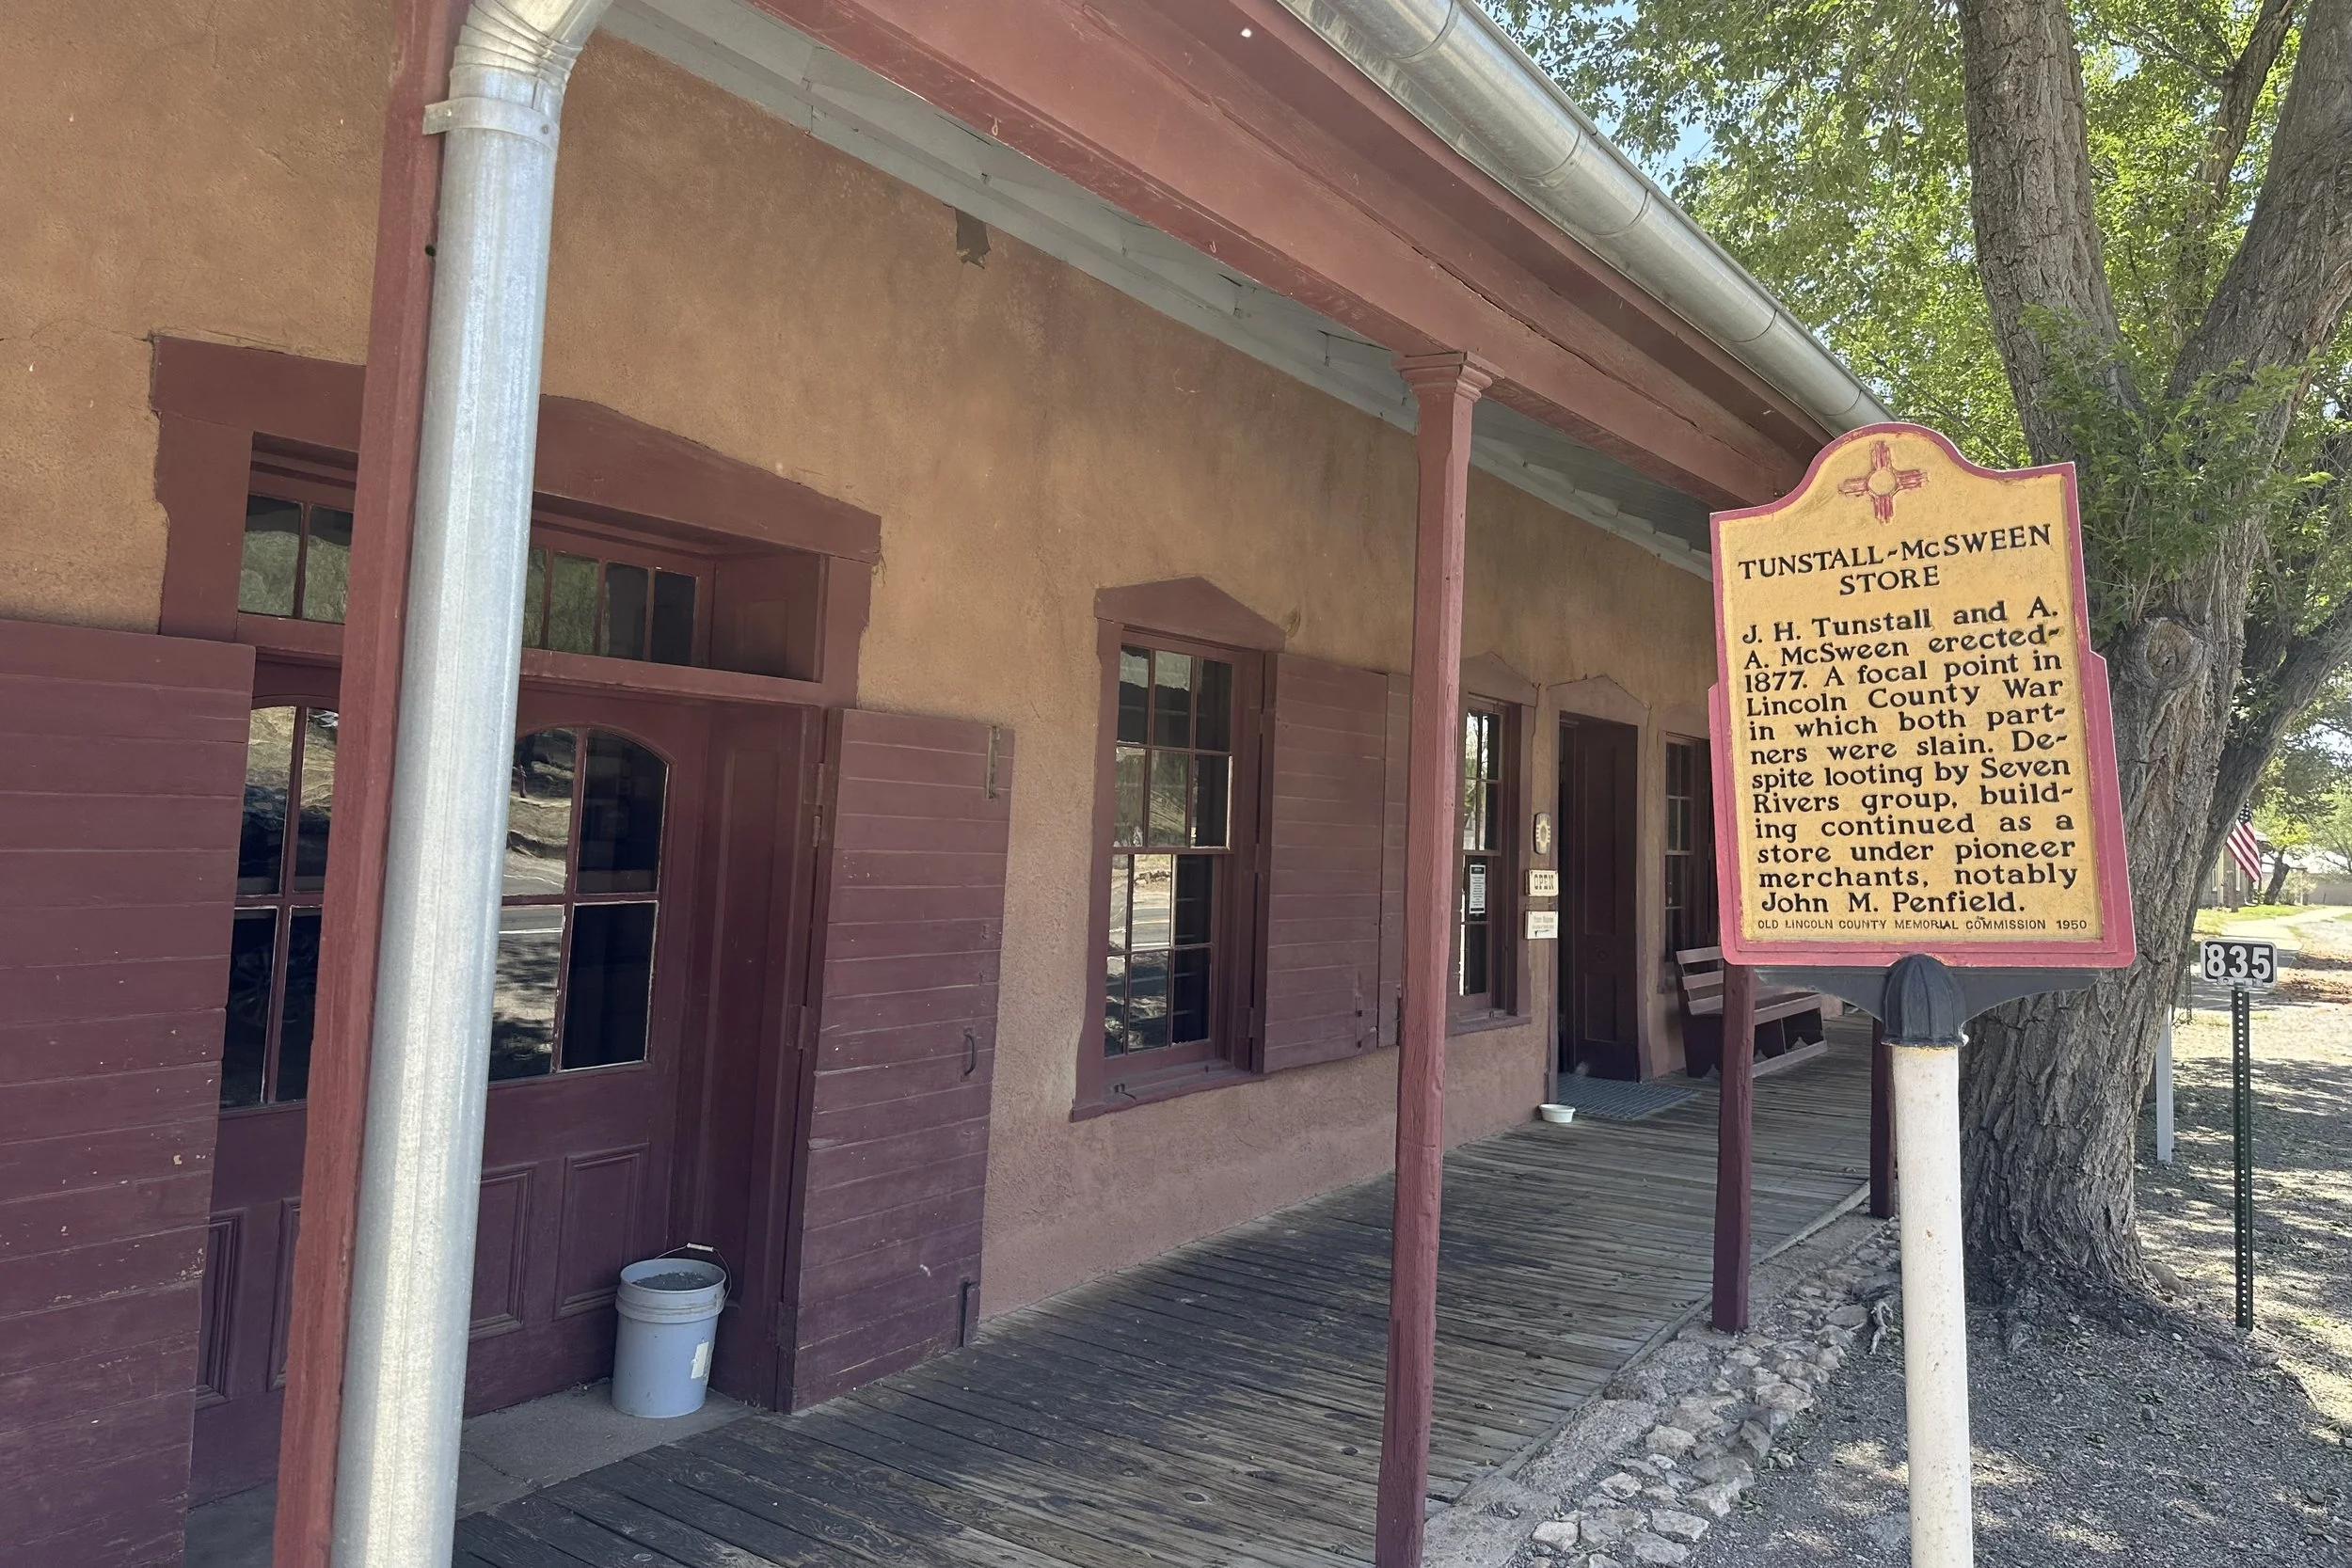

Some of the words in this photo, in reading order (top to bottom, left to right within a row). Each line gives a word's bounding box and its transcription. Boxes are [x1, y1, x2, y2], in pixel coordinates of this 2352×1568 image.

[1840, 565, 1939, 595] STORE
[1742, 625, 1761, 644] J.
[1774, 622, 1801, 641] H.
[1812, 609, 1931, 638] Tunstall
[1954, 601, 2007, 625] and
[2027, 596, 2058, 619] A.
[1744, 650, 1769, 670] A.
[1781, 642, 1909, 666] McSween
[1745, 671, 1807, 692] 1877.
[1824, 666, 1845, 687] A
[1857, 660, 1927, 684] focal
[1944, 654, 2019, 683] point
[2033, 650, 2061, 671] in
[1747, 693, 1847, 719] Lincoln
[1868, 684, 1979, 708] County
[2002, 678, 2063, 699] War
[1750, 721, 1774, 740] in
[1794, 715, 1878, 737] which
[1899, 709, 1966, 731] both
[1987, 703, 2065, 731] part-
[1751, 748, 1807, 765] ners
[1827, 743, 1897, 760] were
[1917, 733, 1993, 755] slain.
[2011, 730, 2067, 752] De-
[1753, 768, 1814, 793] spite
[1824, 764, 1922, 787] looting
[1934, 762, 1969, 785] by
[1981, 757, 2070, 779] Seven
[1753, 793, 1839, 813] Rivers
[1862, 793, 1958, 817] group,
[1979, 783, 2073, 804] build-
[1756, 818, 1797, 843] ing
[1821, 814, 1975, 836] continued
[2000, 816, 2031, 832] as
[2057, 815, 2074, 830] a
[1757, 845, 1831, 863] store
[1851, 841, 1933, 861] under
[1955, 837, 2075, 864] pioneer
[1534, 874, 1554, 890] OPEN
[1759, 867, 1928, 888] merchants,
[1954, 863, 2077, 889] notably
[1762, 893, 1828, 912] John
[1849, 893, 1878, 912] M.
[1893, 891, 2025, 912] Penfield.
[1757, 920, 1779, 929] OLD
[1785, 920, 1834, 929] LINCOLN
[1838, 920, 1887, 930] COUNTY
[1894, 920, 1959, 930] MEMORIAL
[1965, 918, 2046, 930] COMMISSION
[2056, 920, 2088, 930] 1950
[2206, 943, 2271, 979] 835
